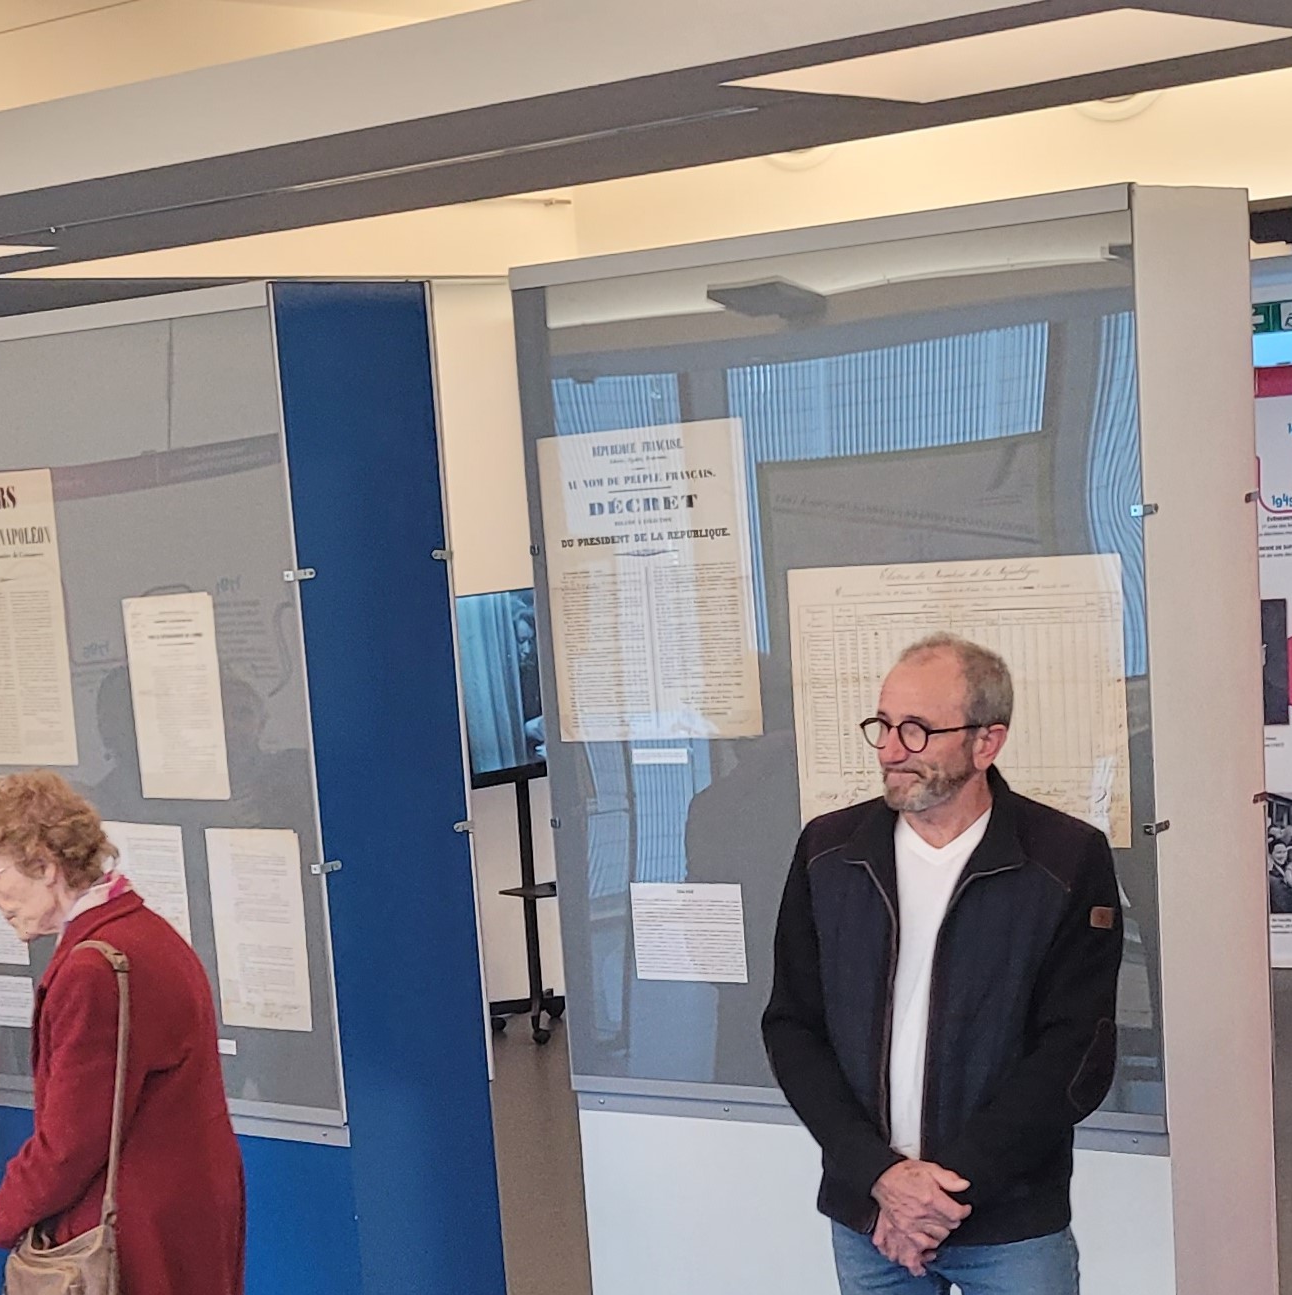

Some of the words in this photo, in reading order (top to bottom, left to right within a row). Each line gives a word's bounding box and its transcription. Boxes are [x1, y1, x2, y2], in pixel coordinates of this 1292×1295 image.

[589, 494, 698, 516] DÉCRET
[561, 539, 574, 548] DU
[634, 532, 647, 543] DE
[651, 532, 663, 541] LA
